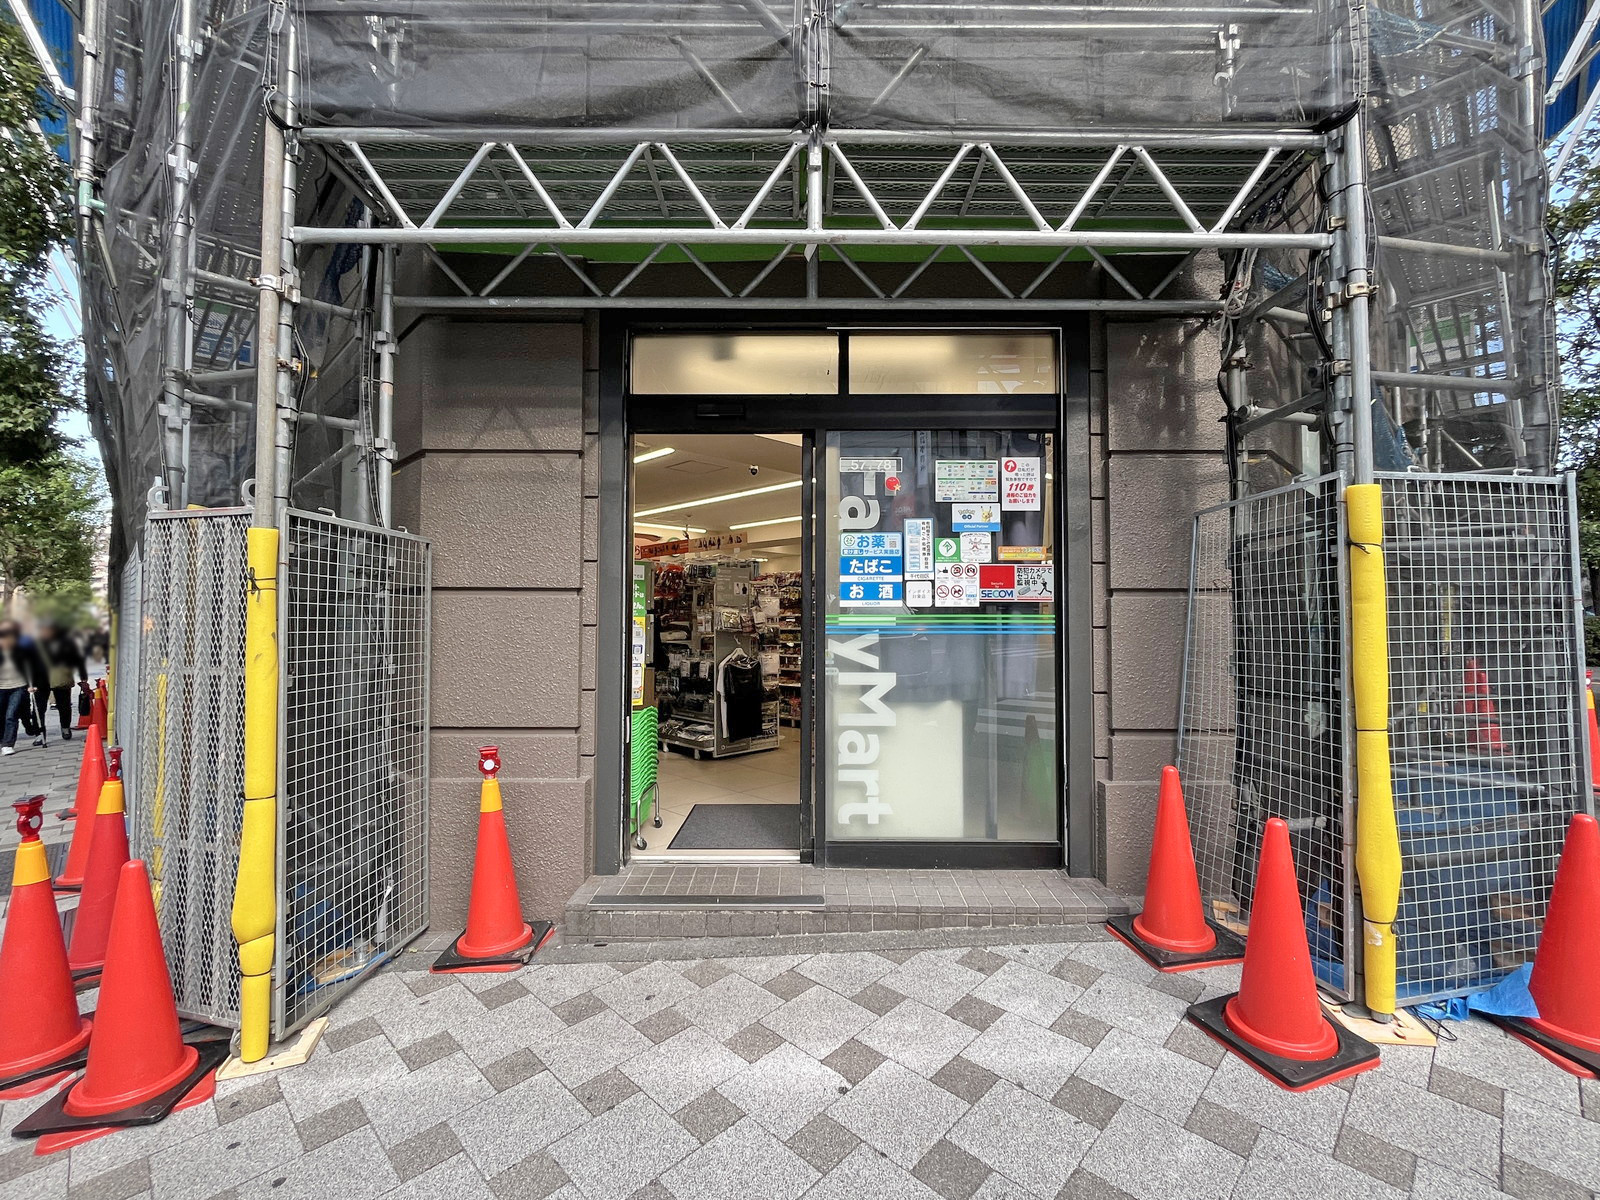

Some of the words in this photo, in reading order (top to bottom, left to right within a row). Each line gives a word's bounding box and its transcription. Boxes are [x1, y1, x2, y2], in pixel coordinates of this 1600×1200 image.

[1008, 482, 1035, 492] 110番
[857, 535, 885, 548] お薬
[849, 559, 893, 574] たばこ
[849, 584, 894, 599] お酒
[981, 589, 1014, 598] SECOM
